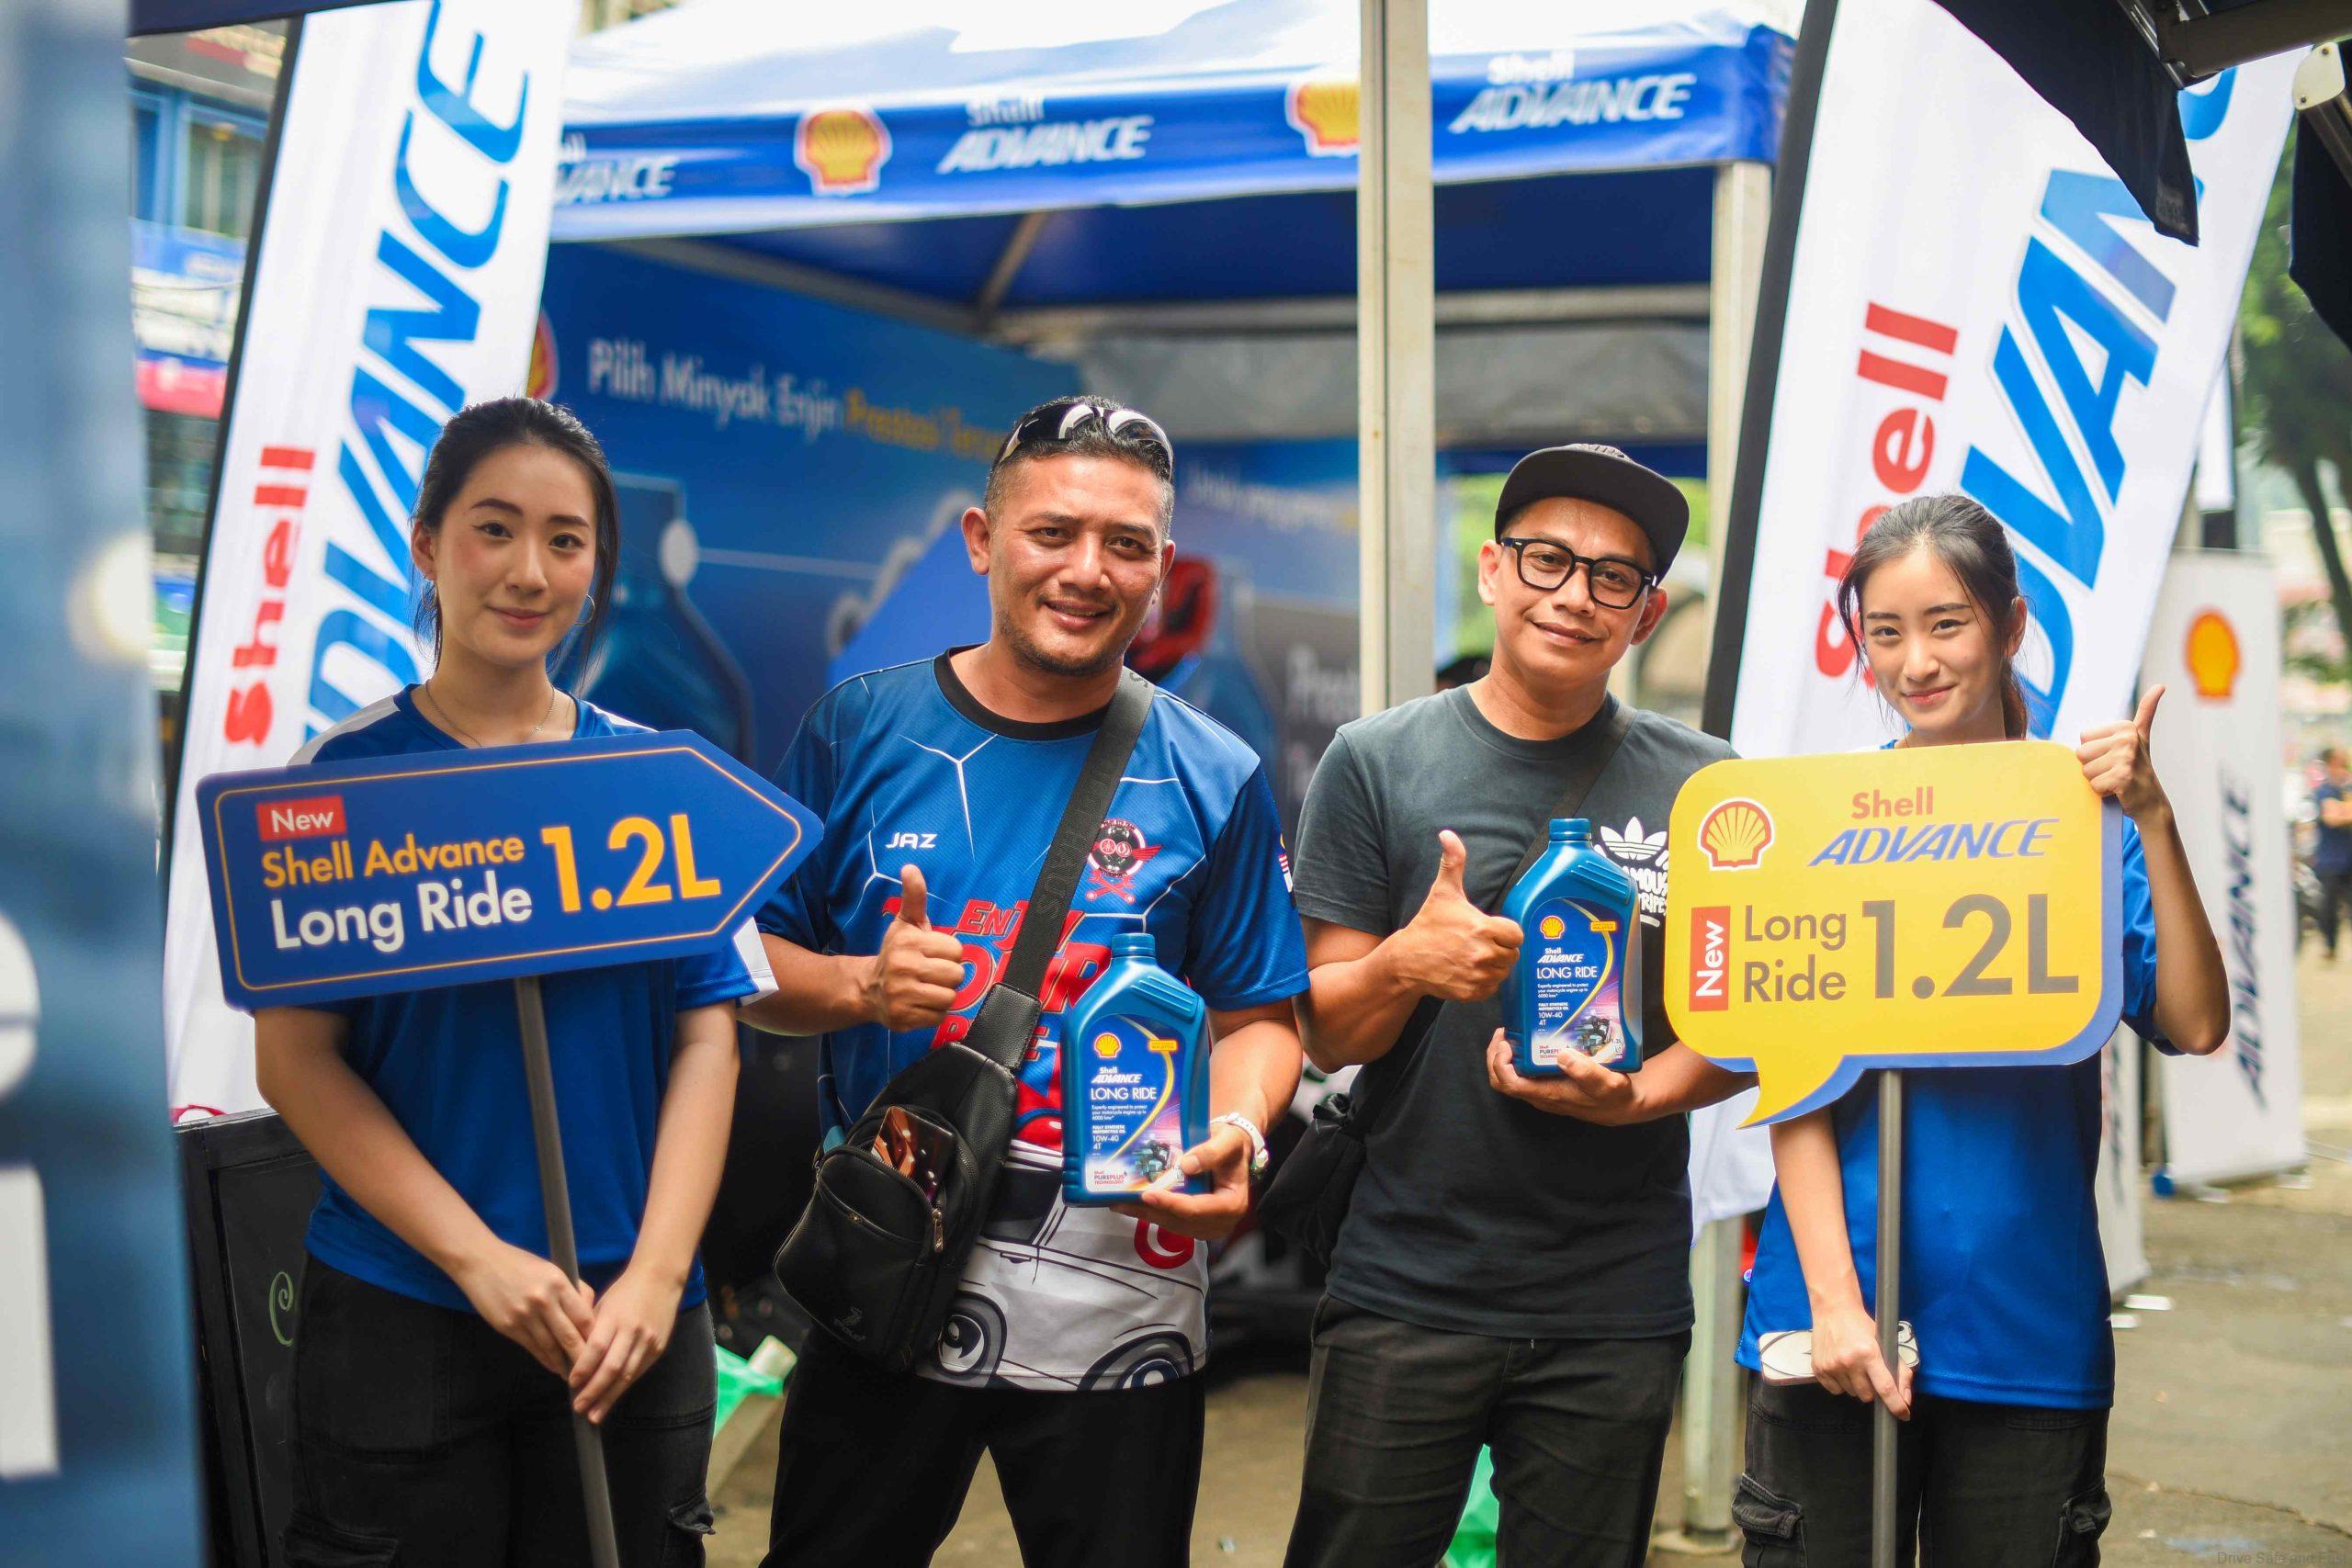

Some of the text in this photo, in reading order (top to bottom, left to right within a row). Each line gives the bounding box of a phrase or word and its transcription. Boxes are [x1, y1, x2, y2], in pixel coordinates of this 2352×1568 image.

[1487, 51, 1574, 85] Shell
[967, 95, 1046, 127] Shell
[1448, 73, 1696, 134] ADVANCE
[936, 115, 1154, 174] ADVANCE
[304, 0, 530, 742] DVANCE
[589, 338, 655, 400] Pilih
[661, 352, 770, 429] Minyak
[223, 446, 316, 748] Shell
[272, 807, 334, 834] New
[1851, 787, 1934, 819] Shell
[263, 833, 526, 889] Shell Advance
[541, 813, 721, 913] 1.2L
[886, 832, 937, 850] JAZ
[1807, 818, 2060, 868] ADVANCE
[271, 871, 532, 953] Long Ride
[1745, 905, 1848, 951] Long
[1537, 953, 1585, 964] ADVANCE
[1695, 920, 1724, 998] New
[1861, 894, 2079, 999] 1.2L
[1537, 966, 1598, 979] LONG RIDE
[1745, 954, 1848, 1003] Ride
[1091, 1074, 1143, 1084] ADVANCE
[1091, 1088, 1157, 1100] LONG RIDE
